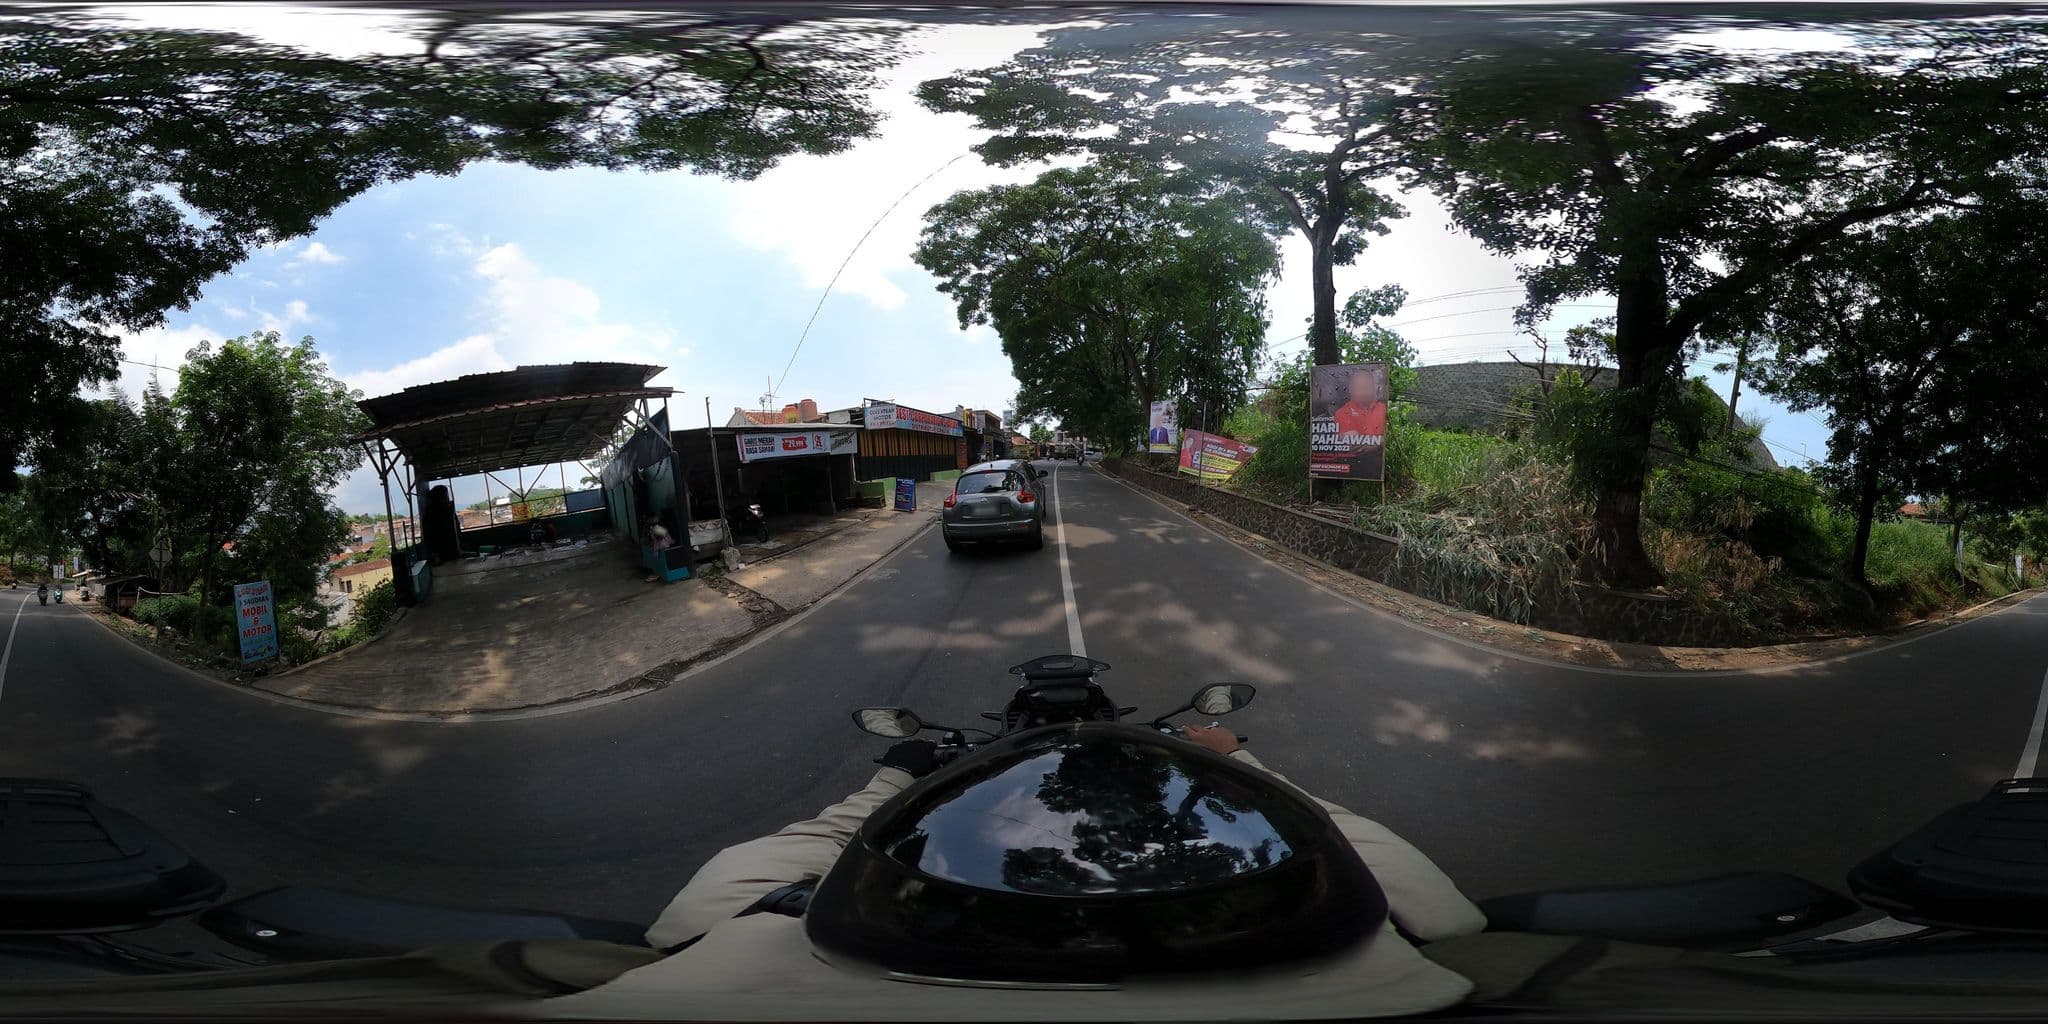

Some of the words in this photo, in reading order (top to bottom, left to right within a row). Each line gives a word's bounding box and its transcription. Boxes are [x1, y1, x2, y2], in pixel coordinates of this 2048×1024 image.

[1312, 423, 1340, 433] HARI
[1312, 434, 1381, 445] PAHLAWAN
[243, 606, 267, 617] MOBIL
[243, 625, 271, 638] MOTOR
